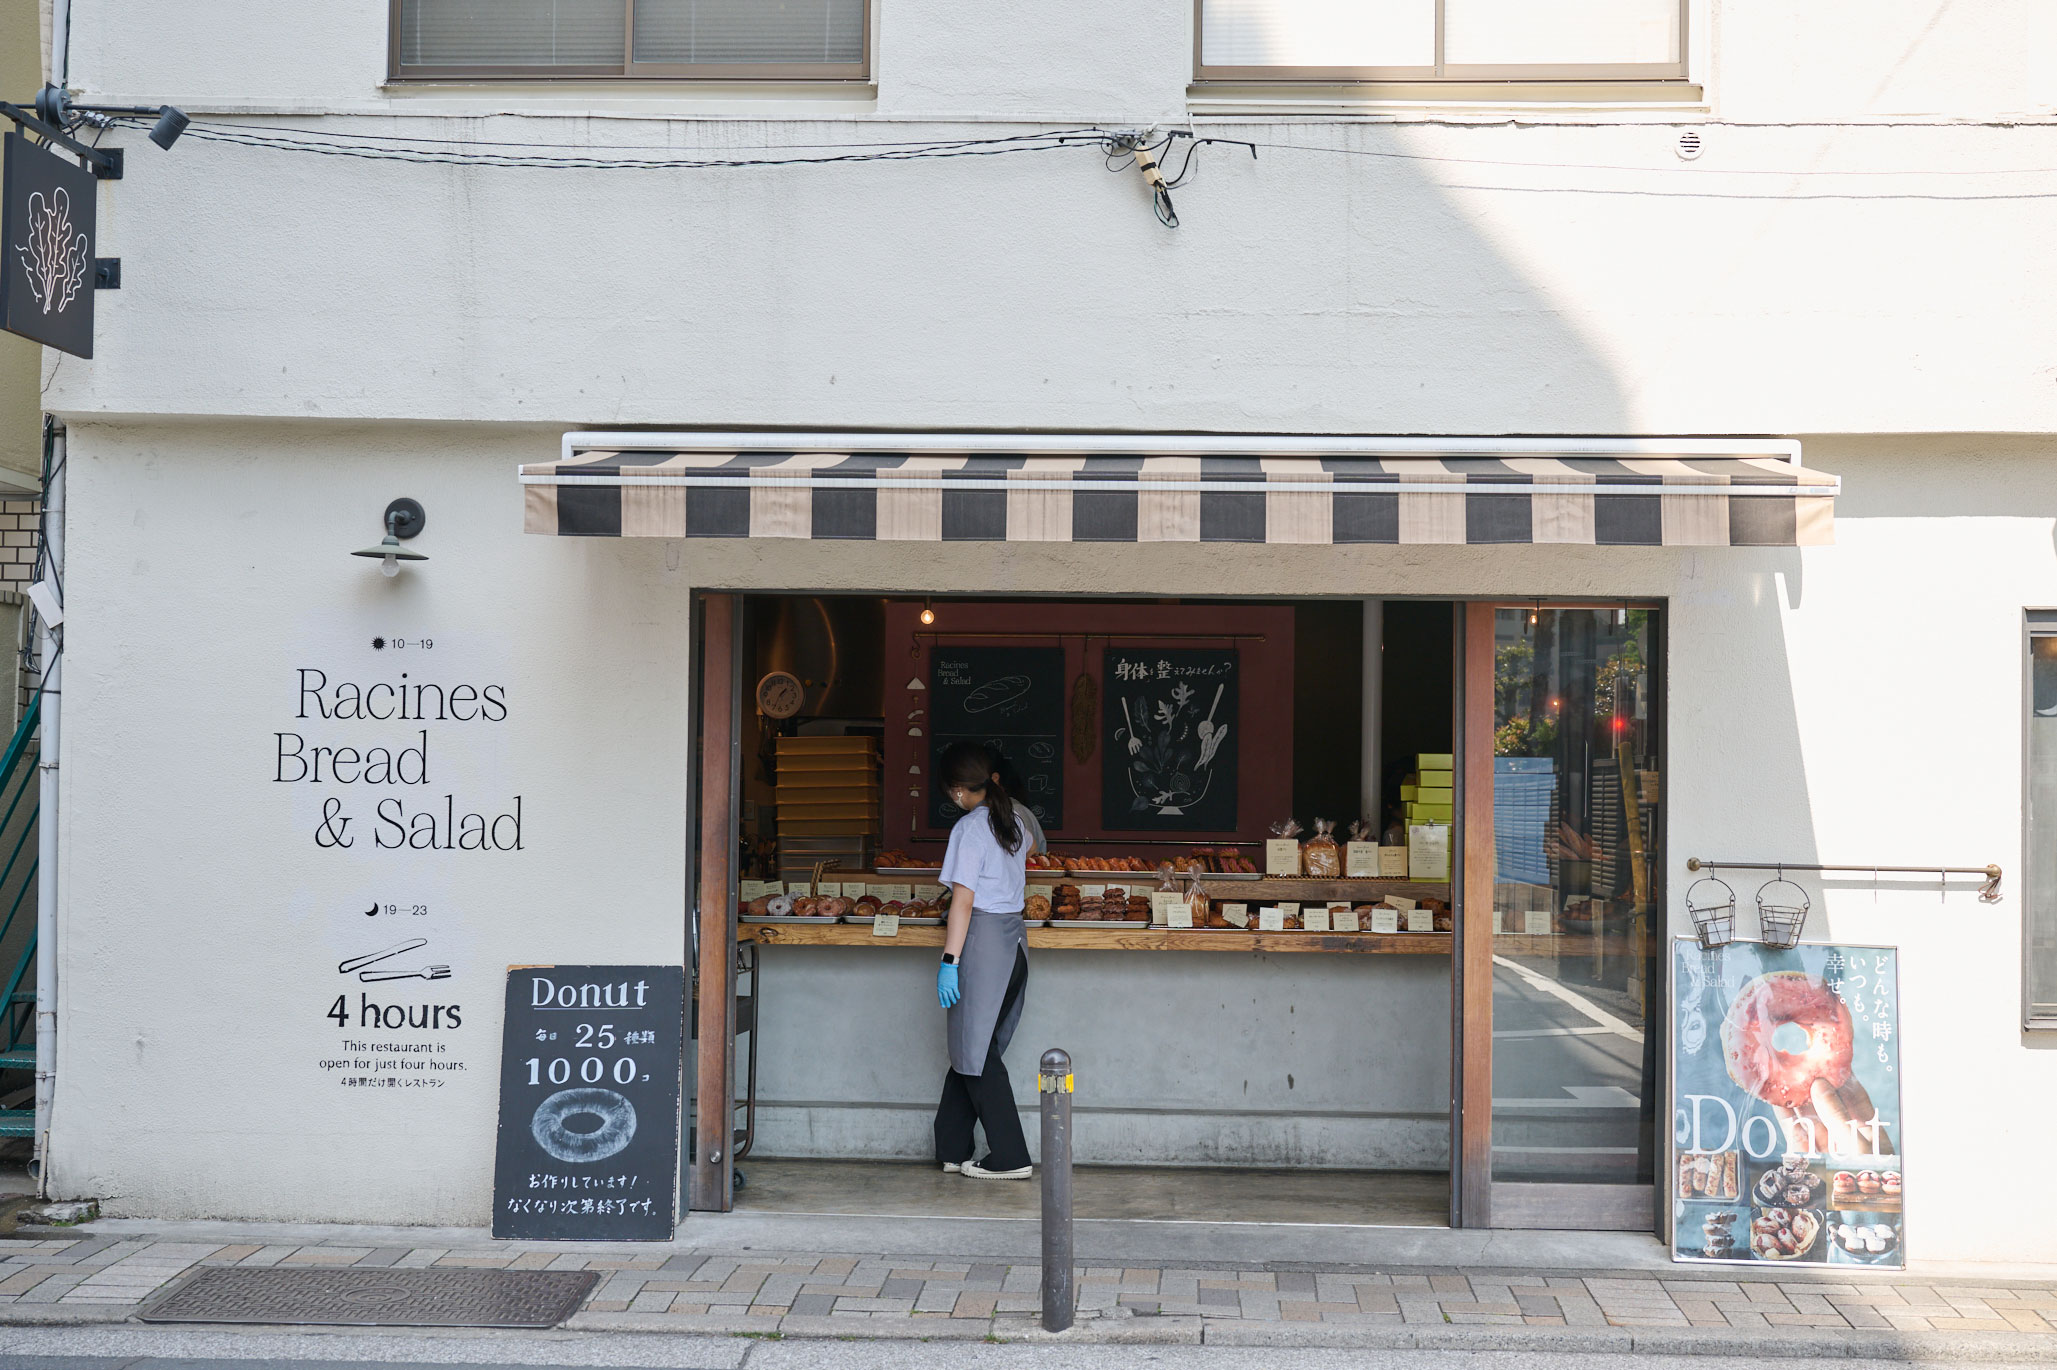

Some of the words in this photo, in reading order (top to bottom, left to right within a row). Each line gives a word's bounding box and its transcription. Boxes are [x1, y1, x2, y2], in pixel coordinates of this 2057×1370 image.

[940, 661, 969, 669] Racines
[295, 668, 508, 722] Racines
[950, 676, 972, 685] Salad
[272, 730, 430, 784] Bread
[315, 798, 354, 848] &
[374, 794, 525, 850] Salad
[531, 978, 650, 1008] Donut
[1826, 953, 1846, 1004] 幸せ。
[1849, 956, 1869, 1022] いつも。
[327, 995, 349, 1028] 4
[361, 992, 462, 1029] hours
[1872, 956, 1893, 1072] どんな時も。
[342, 1040, 366, 1052] This
[371, 1042, 432, 1052] restaurant
[437, 1042, 446, 1052] is
[536, 1028, 558, 1042] 毎日
[575, 1024, 615, 1049] 25
[624, 1030, 655, 1044] 種類
[320, 1060, 350, 1071] open
[354, 1058, 370, 1069] for
[374, 1059, 396, 1072] just
[400, 1059, 425, 1070] four
[430, 1060, 467, 1071] hours.
[341, 1077, 445, 1088] 4時間だけ開くレストラン
[1684, 1094, 1893, 1160] Donut
[529, 1174, 638, 1190] お作りしています!
[508, 1198, 657, 1216] なくなり次第終了です。
